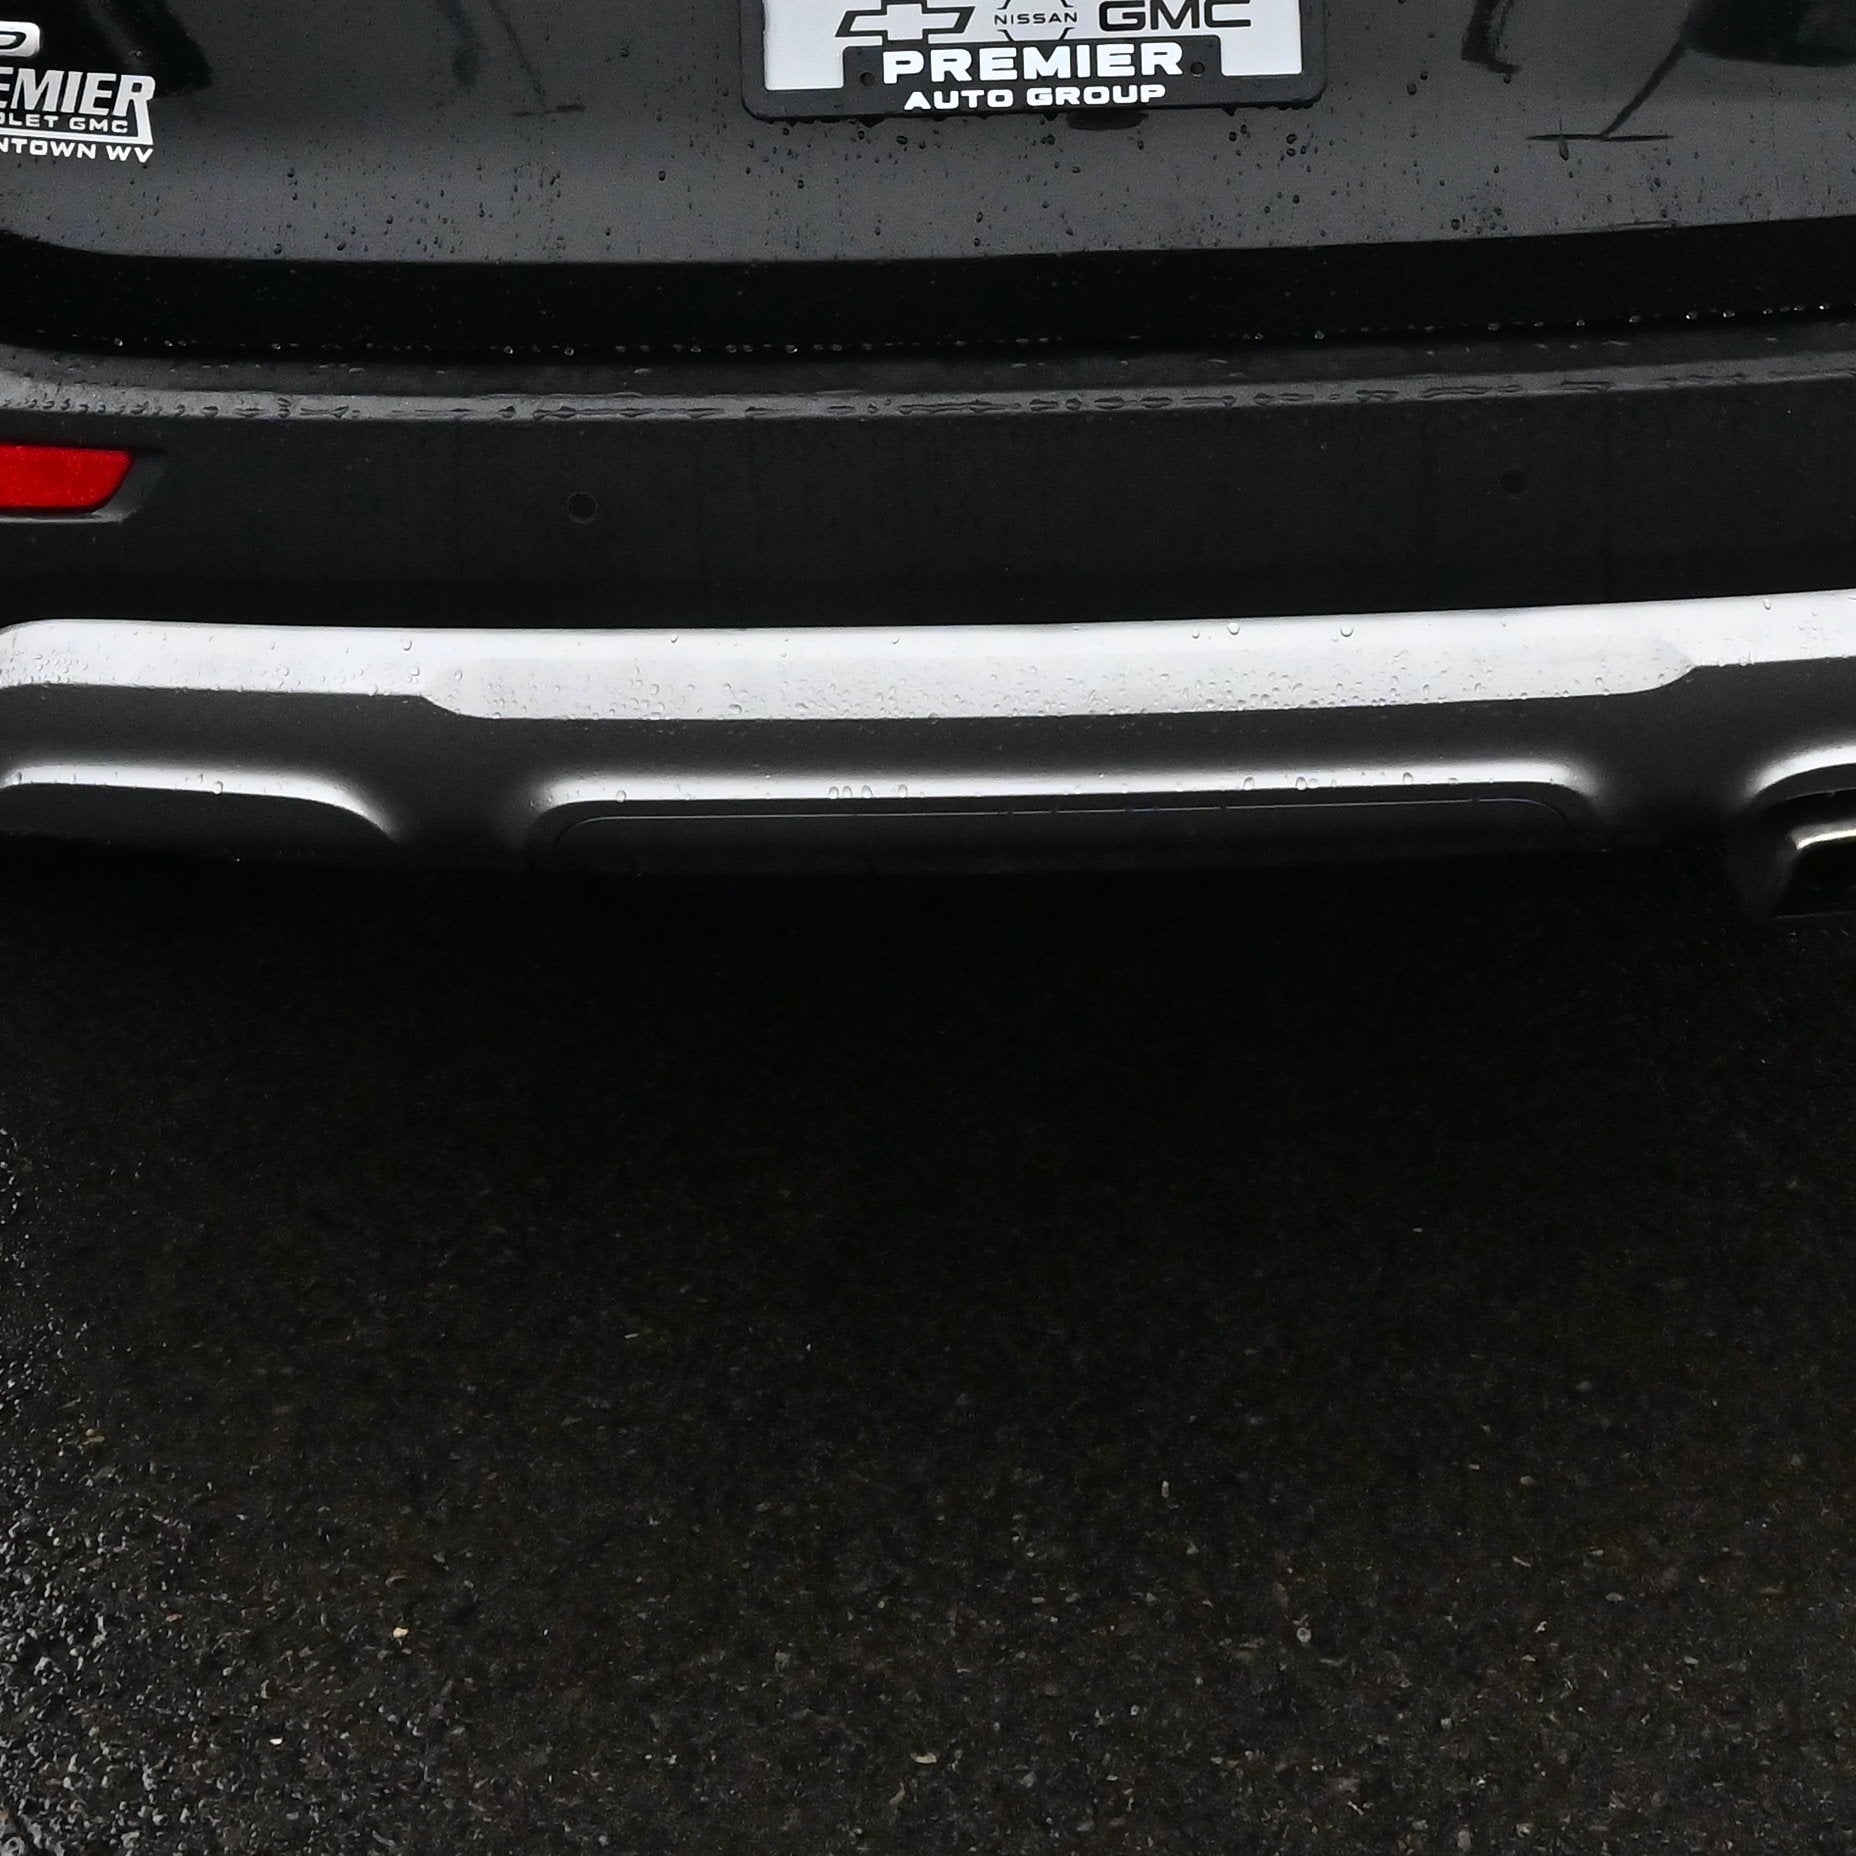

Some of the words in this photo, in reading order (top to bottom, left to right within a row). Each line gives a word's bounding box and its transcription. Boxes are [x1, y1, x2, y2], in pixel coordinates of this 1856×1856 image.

[994, 11, 1078, 27] NISSAN
[882, 41, 1183, 85] PREMIER
[904, 89, 1014, 110] AUTO
[1026, 83, 1166, 105] GROUP
[68, 116, 129, 134] GMC
[106, 145, 154, 163] WV
